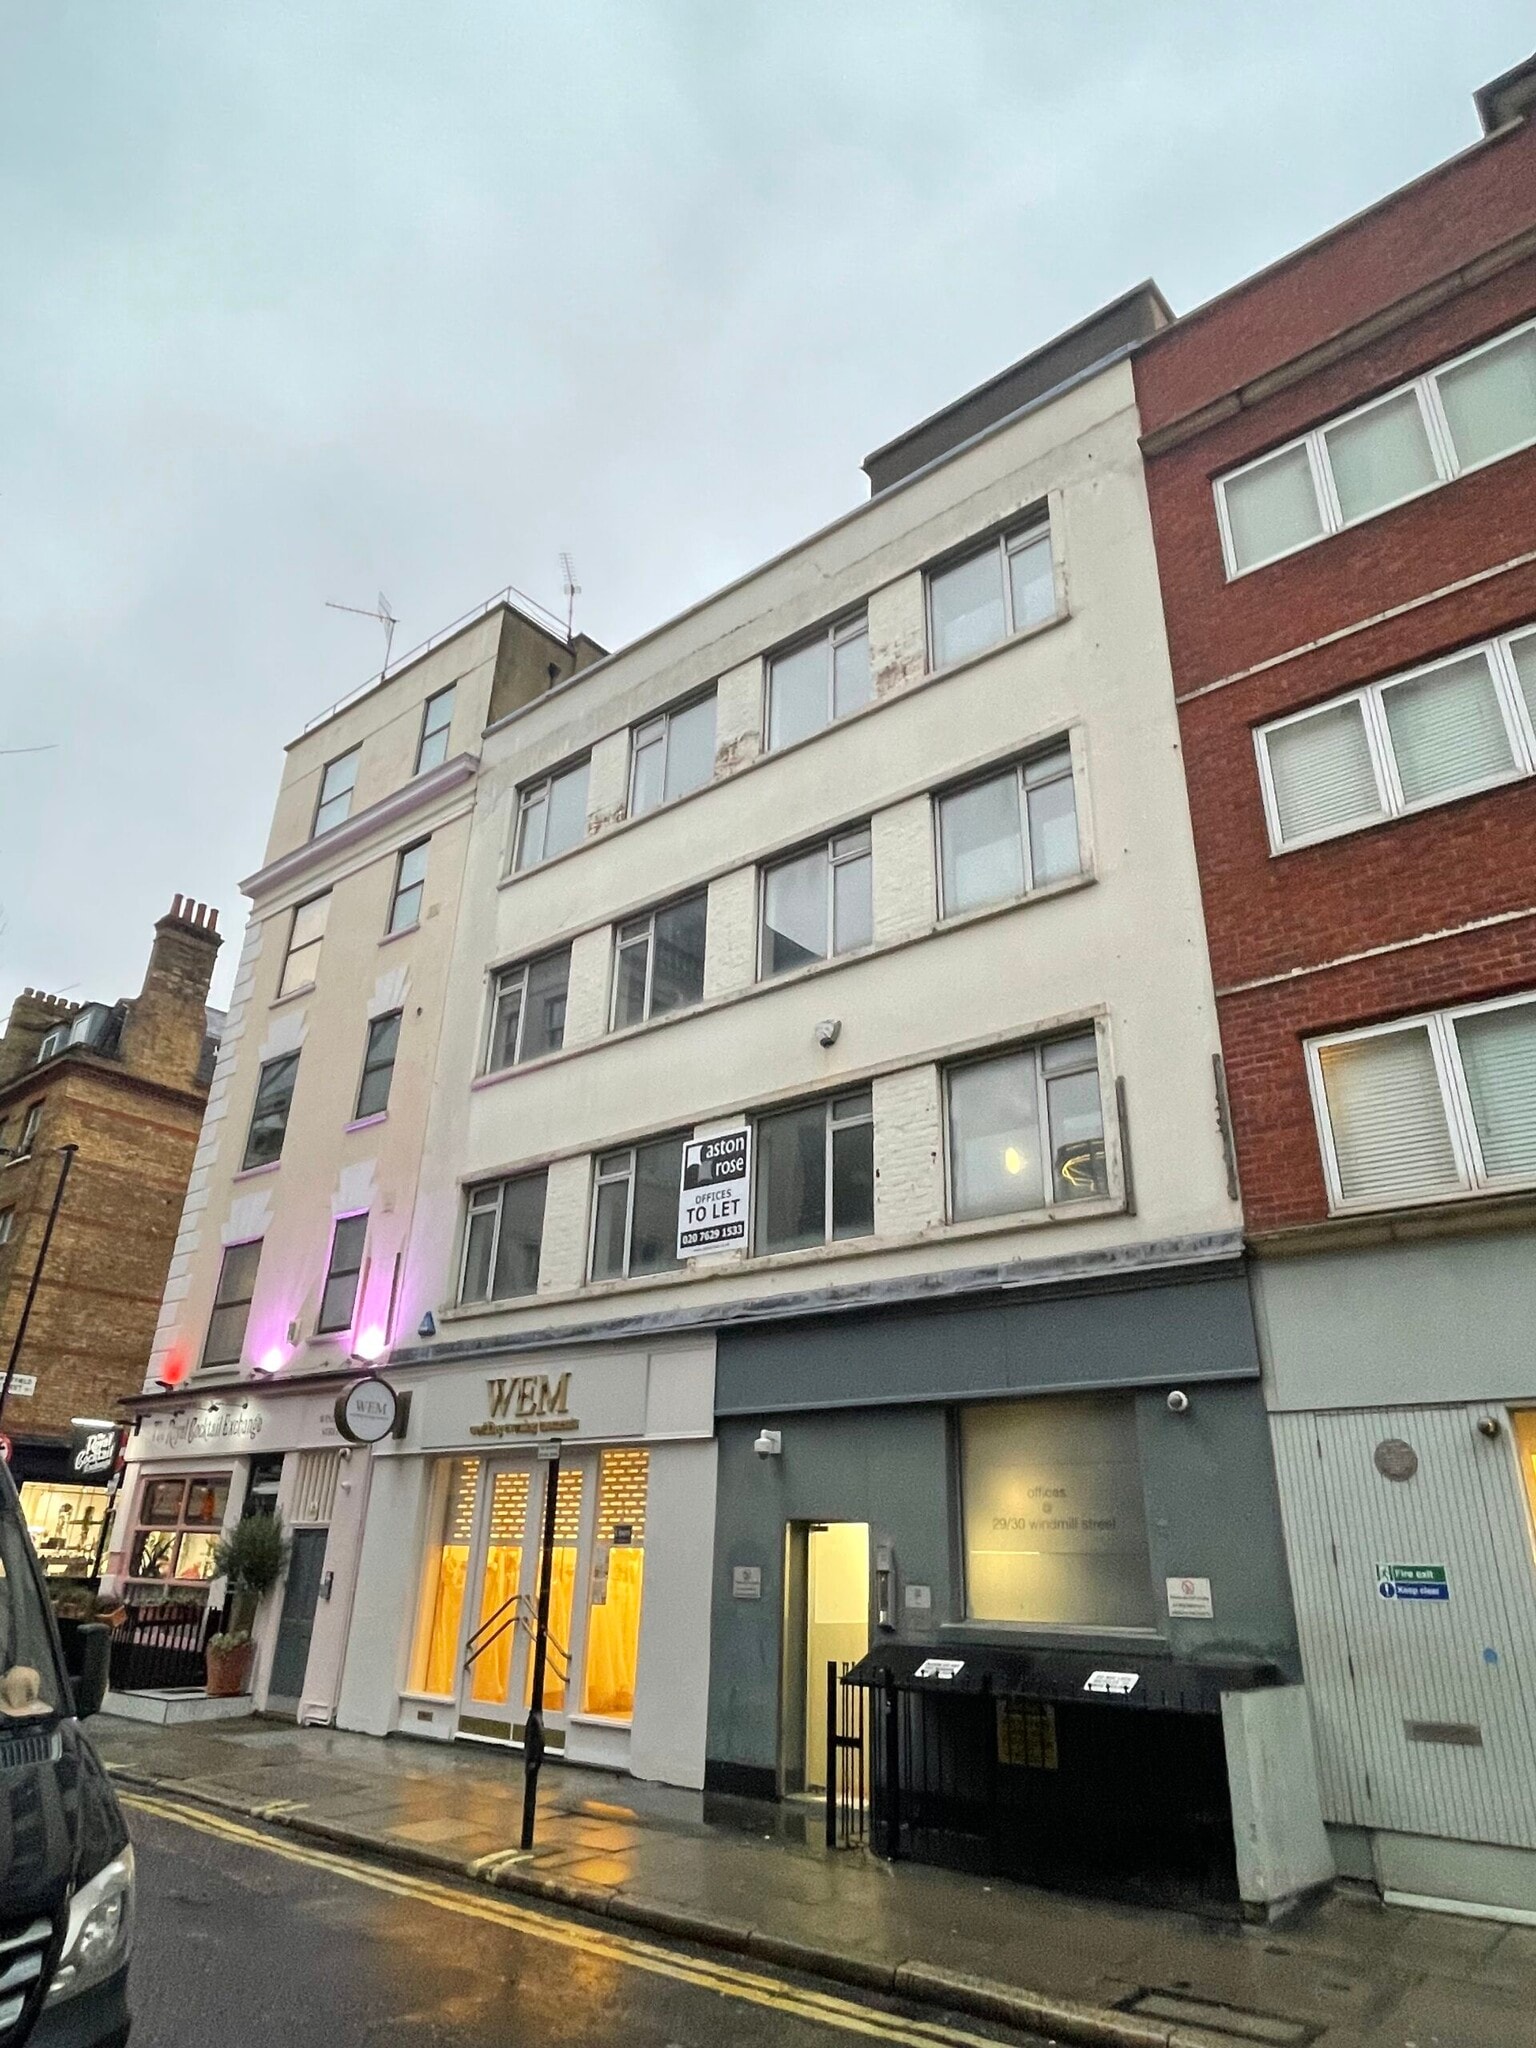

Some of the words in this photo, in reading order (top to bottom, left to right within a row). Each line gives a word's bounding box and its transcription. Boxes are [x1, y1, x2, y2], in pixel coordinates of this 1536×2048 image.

[706, 1136, 745, 1159] aston
[715, 1157, 744, 1176] rose
[695, 1188, 732, 1205] OFFICES
[686, 1205, 707, 1224] TO
[712, 1198, 740, 1219] LET
[682, 1233, 698, 1245] 020
[700, 1228, 720, 1243] 7629
[722, 1224, 743, 1238] 1533
[486, 1372, 572, 1418] WEM
[356, 1400, 388, 1416] WEM
[1026, 1487, 1068, 1499] offices
[993, 1518, 1026, 1530] 29/30
[1028, 1517, 1079, 1530] windmill
[1082, 1518, 1117, 1531] street
[1395, 1569, 1414, 1578] Fire
[1415, 1570, 1433, 1579] exit
